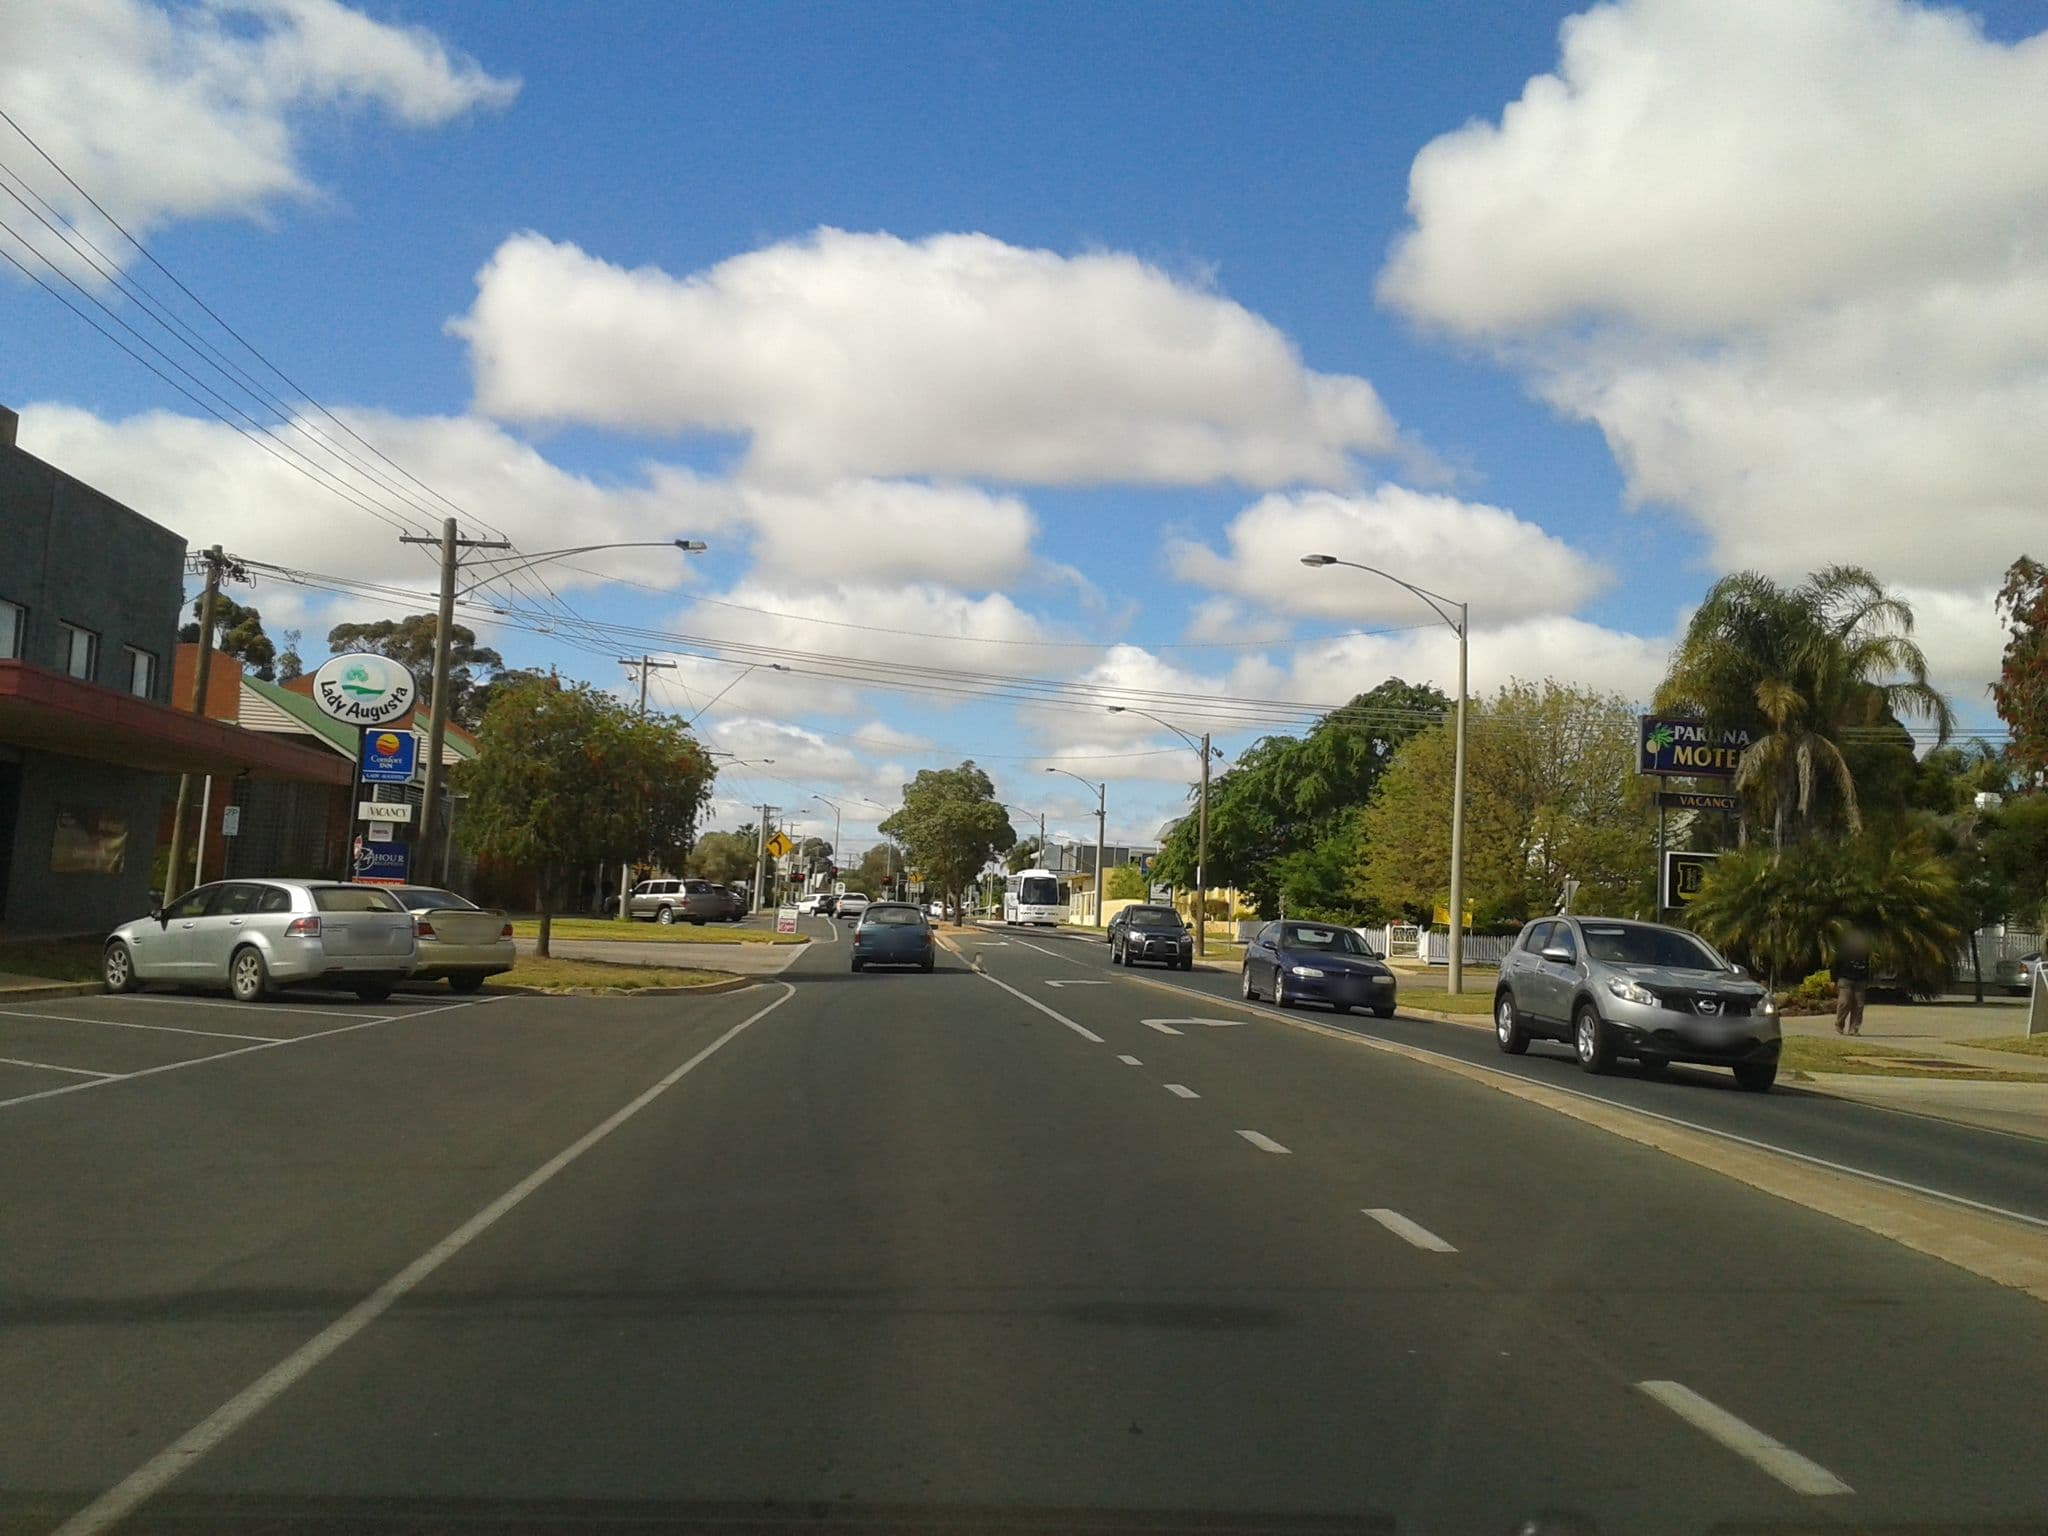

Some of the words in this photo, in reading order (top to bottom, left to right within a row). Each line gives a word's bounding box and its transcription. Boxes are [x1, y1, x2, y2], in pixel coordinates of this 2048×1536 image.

[320, 681, 347, 714] Lady
[346, 687, 409, 721] Augusta
[1673, 725, 1751, 746] PARNA
[1673, 745, 1740, 769] MOTE
[1680, 796, 1737, 809] VACANCY
[369, 806, 408, 817] VACANCY
[374, 853, 405, 863] HOUR
